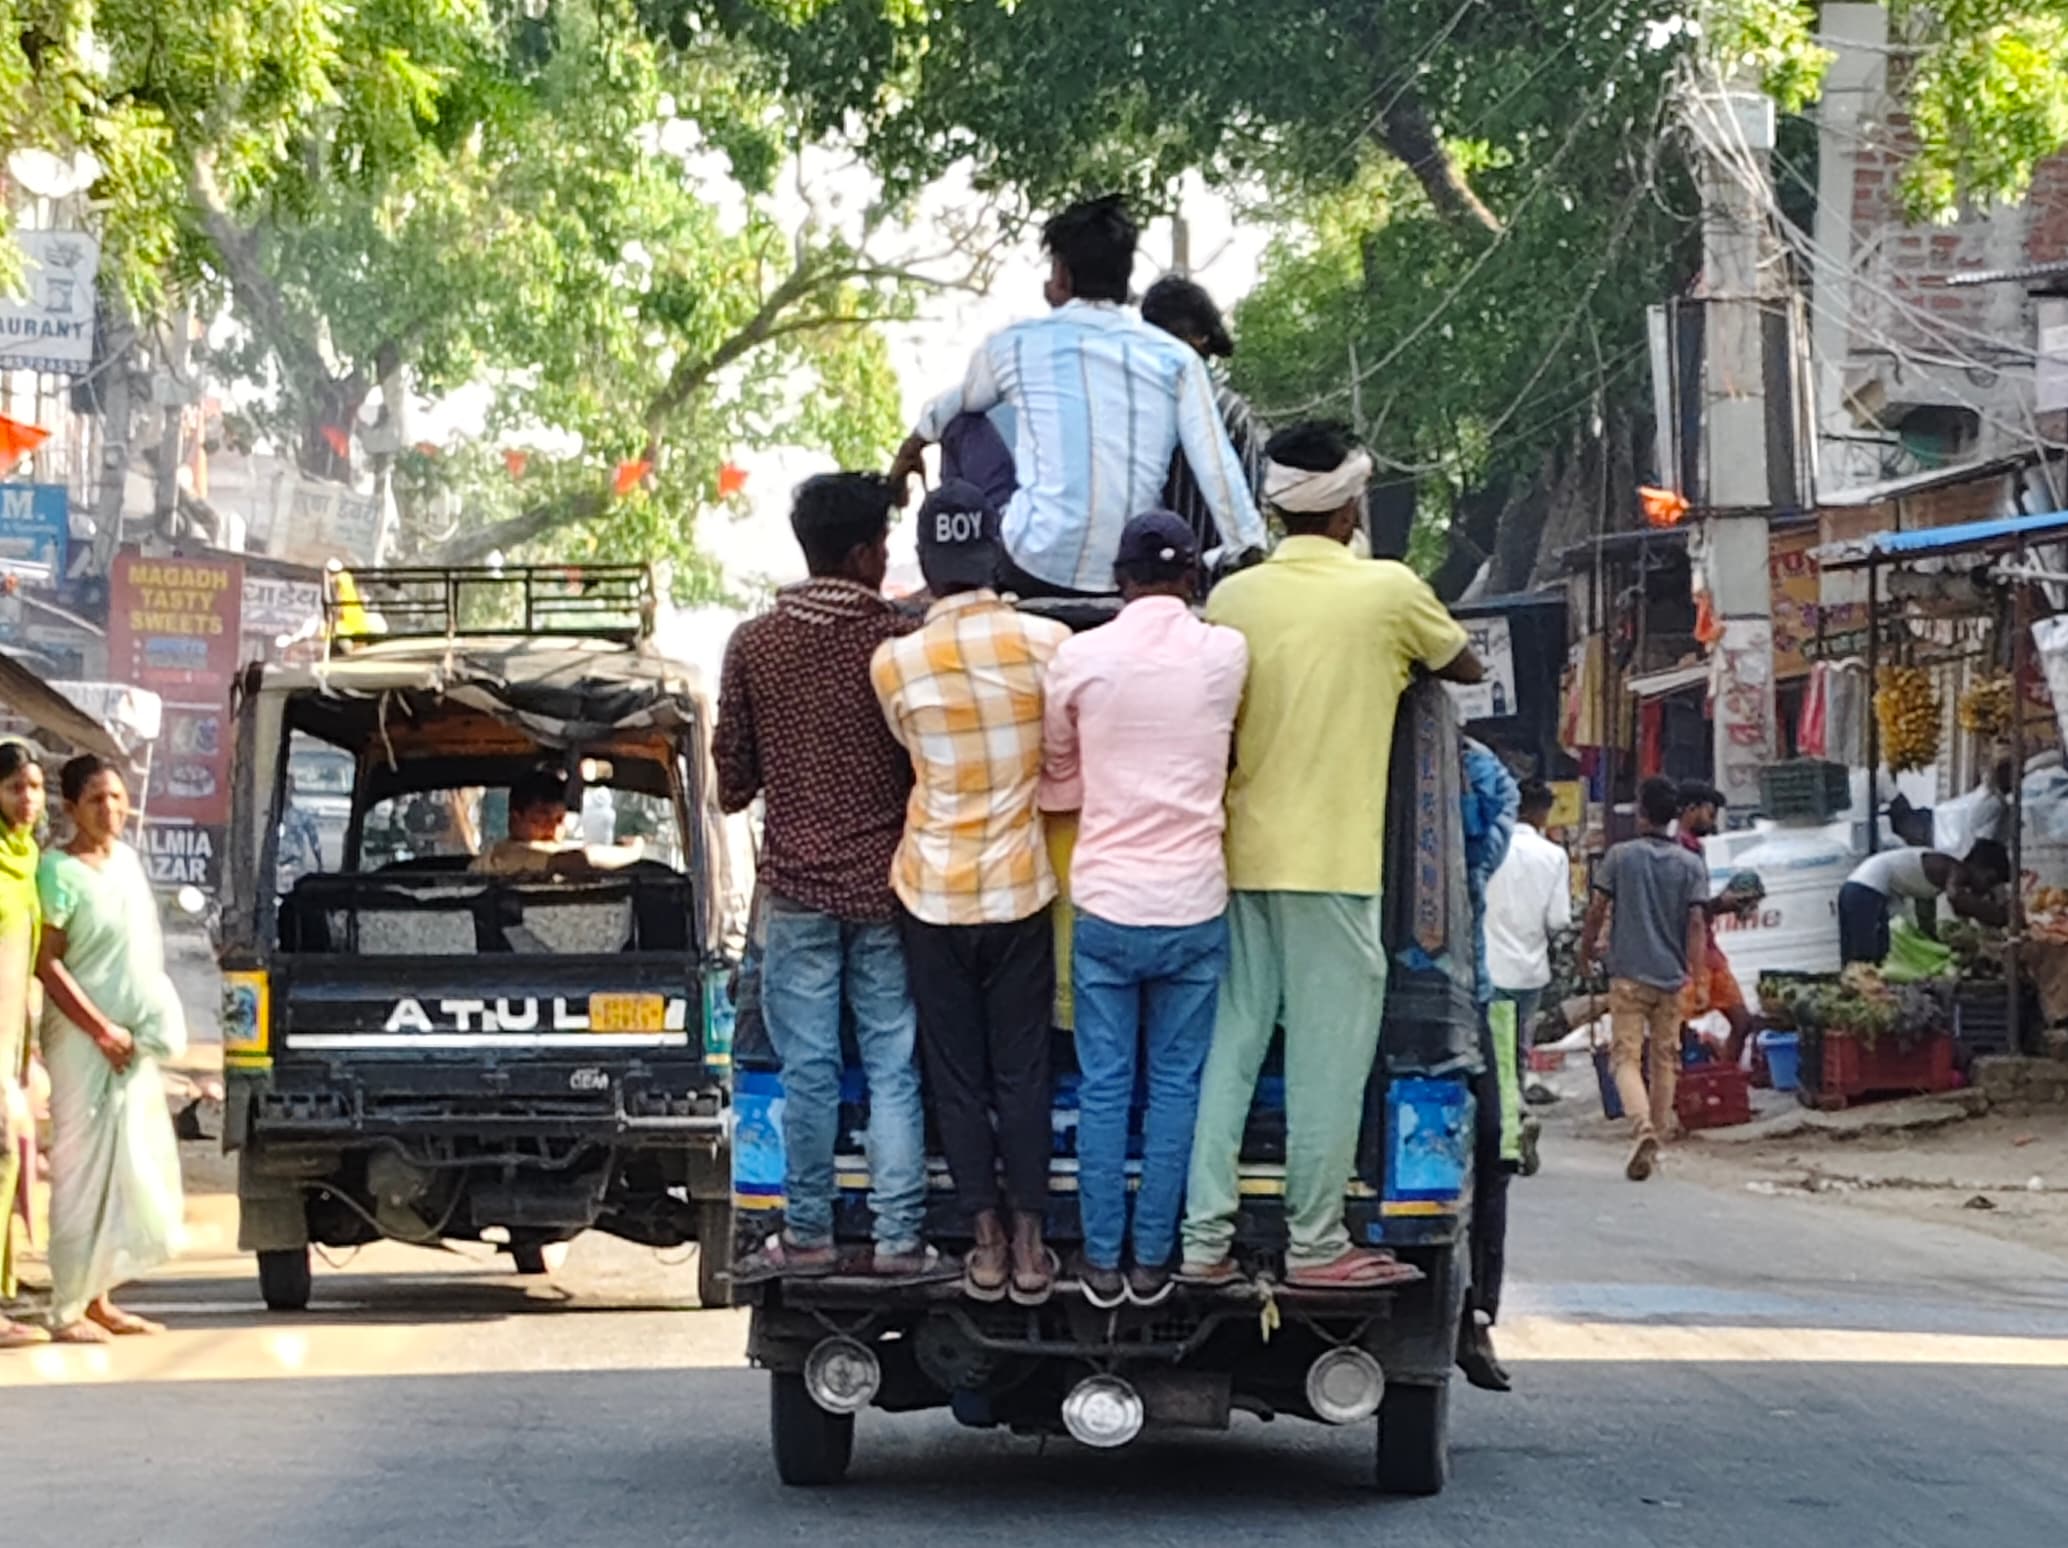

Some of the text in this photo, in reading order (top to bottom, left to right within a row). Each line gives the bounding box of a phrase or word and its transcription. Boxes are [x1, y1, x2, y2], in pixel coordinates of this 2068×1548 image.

[936, 510, 983, 543] BOY
[128, 564, 228, 589] MAGADH
[141, 588, 214, 611] TASTY
[130, 611, 223, 635] SWEETS
[142, 855, 206, 883] AZAR
[385, 996, 590, 1032] ATUL
